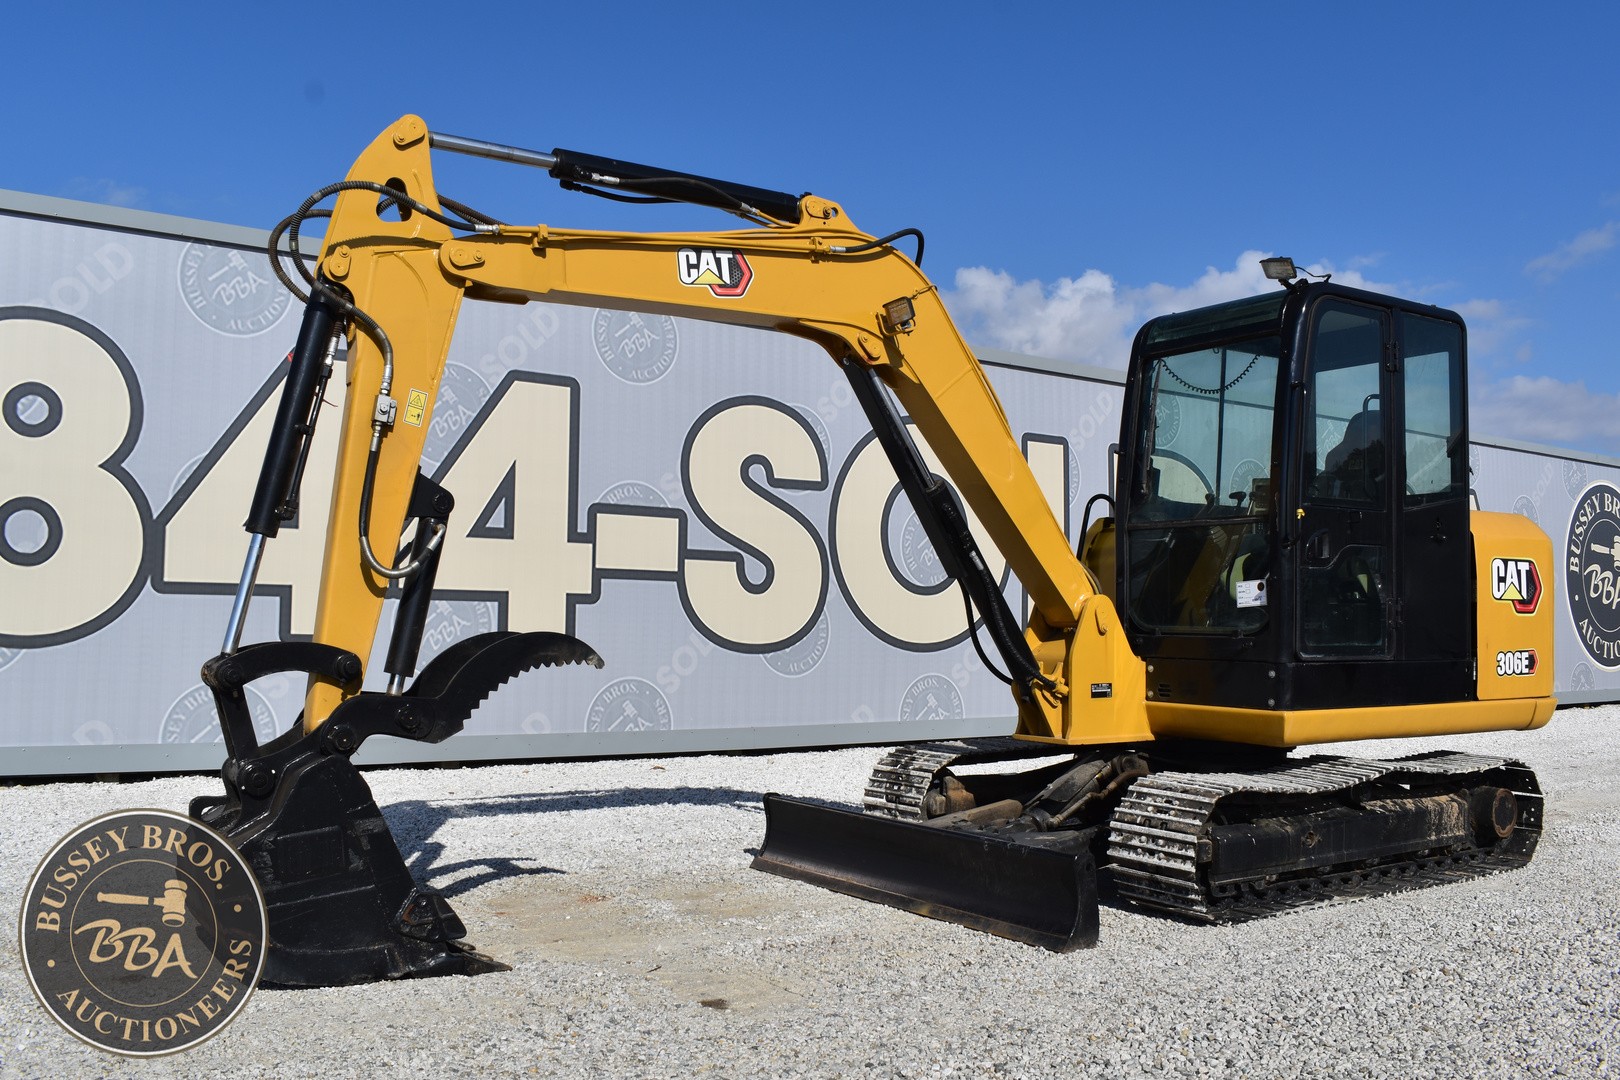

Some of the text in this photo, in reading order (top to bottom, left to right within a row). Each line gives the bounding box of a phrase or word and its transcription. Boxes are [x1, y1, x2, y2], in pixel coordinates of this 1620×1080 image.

[35, 242, 135, 314] OLD
[678, 248, 733, 284] CAT
[212, 271, 269, 306] BBA
[617, 328, 660, 358] BBA
[427, 404, 476, 438] BBA
[1570, 493, 1600, 574] BUSSEY
[1492, 559, 1530, 600] CAT
[423, 615, 472, 650] BBA
[657, 632, 715, 694] SOL
[1497, 652, 1529, 675] 306E
[603, 682, 640, 703] BROS.
